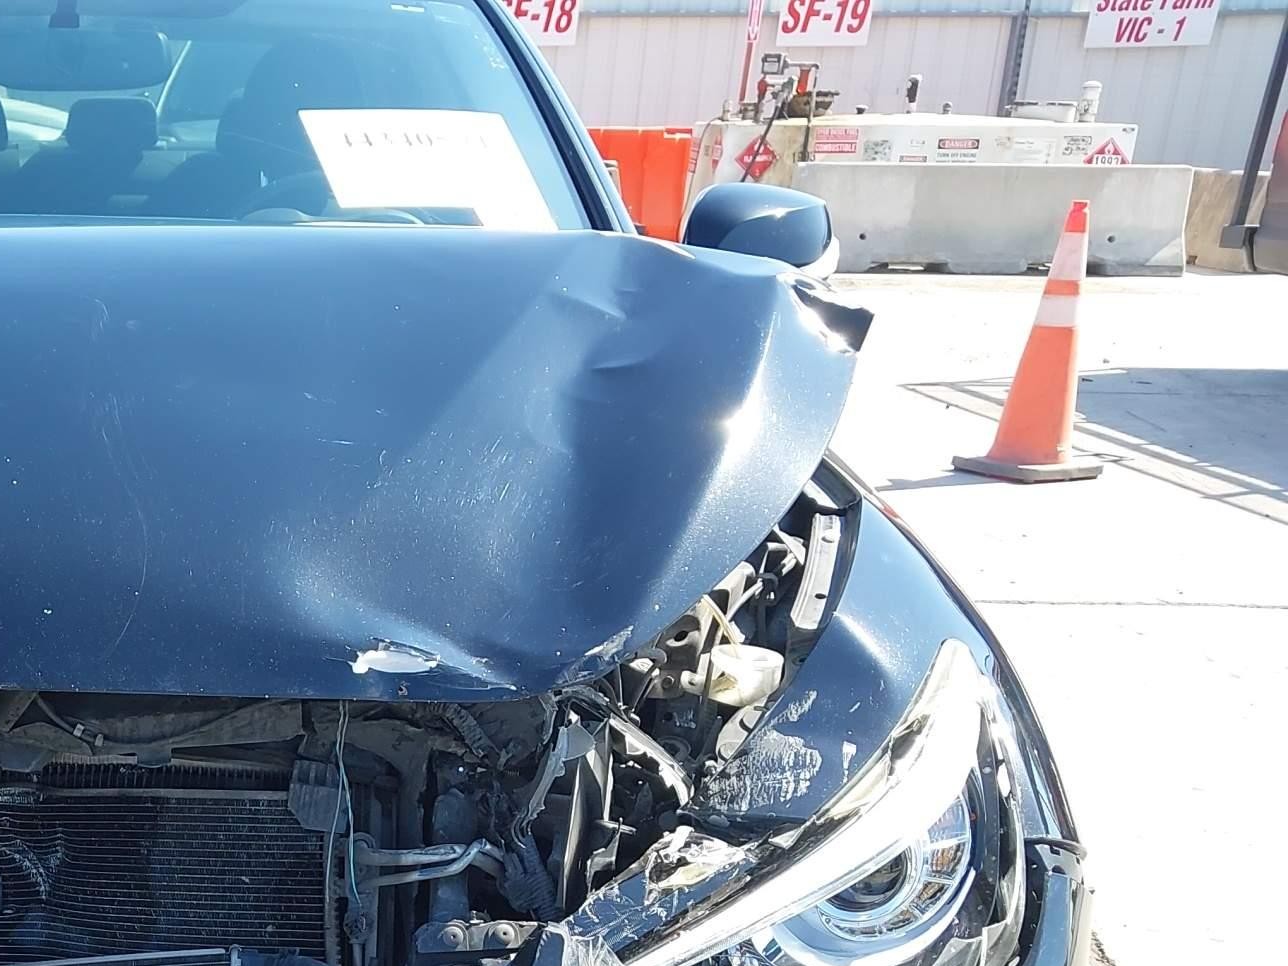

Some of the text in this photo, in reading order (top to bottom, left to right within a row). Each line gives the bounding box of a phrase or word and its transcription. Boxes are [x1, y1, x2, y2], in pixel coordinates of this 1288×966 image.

[781, 0, 871, 34] SF-19
[1114, 16, 1153, 43] VIC
[1172, 16, 1187, 42] 1
[944, 140, 972, 148] DANGER
